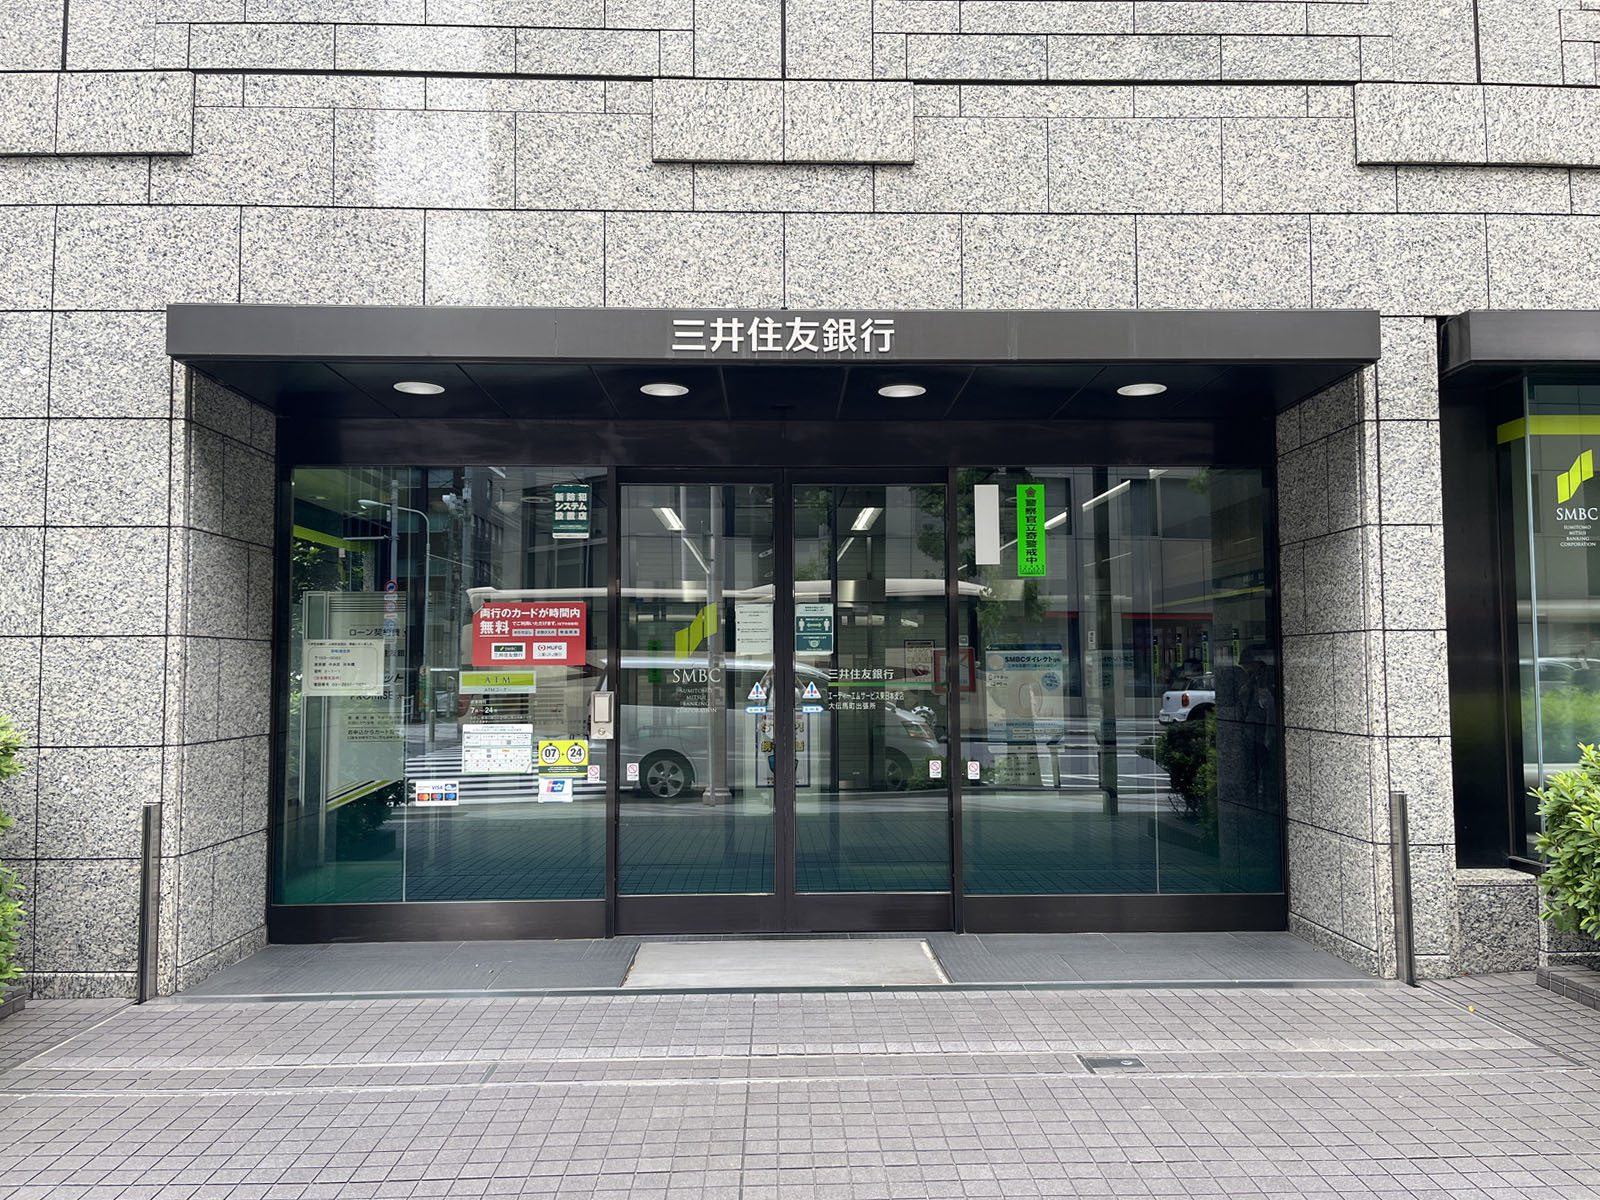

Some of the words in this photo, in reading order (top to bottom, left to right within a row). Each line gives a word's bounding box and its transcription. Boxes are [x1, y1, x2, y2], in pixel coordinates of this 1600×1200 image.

[671, 316, 896, 353] 三井住友銀行
[554, 502, 588, 511] システム
[1556, 507, 1599, 521] SMBC
[479, 607, 581, 619] 両行のカードが時間内
[479, 620, 510, 635] 無料
[485, 676, 511, 684] ATM
[672, 667, 721, 684] SMBC
[828, 668, 895, 680] 三井住友銀行
[828, 702, 877, 710] 大伝馬町出張所
[544, 748, 557, 758] 07
[570, 748, 583, 758] 24
